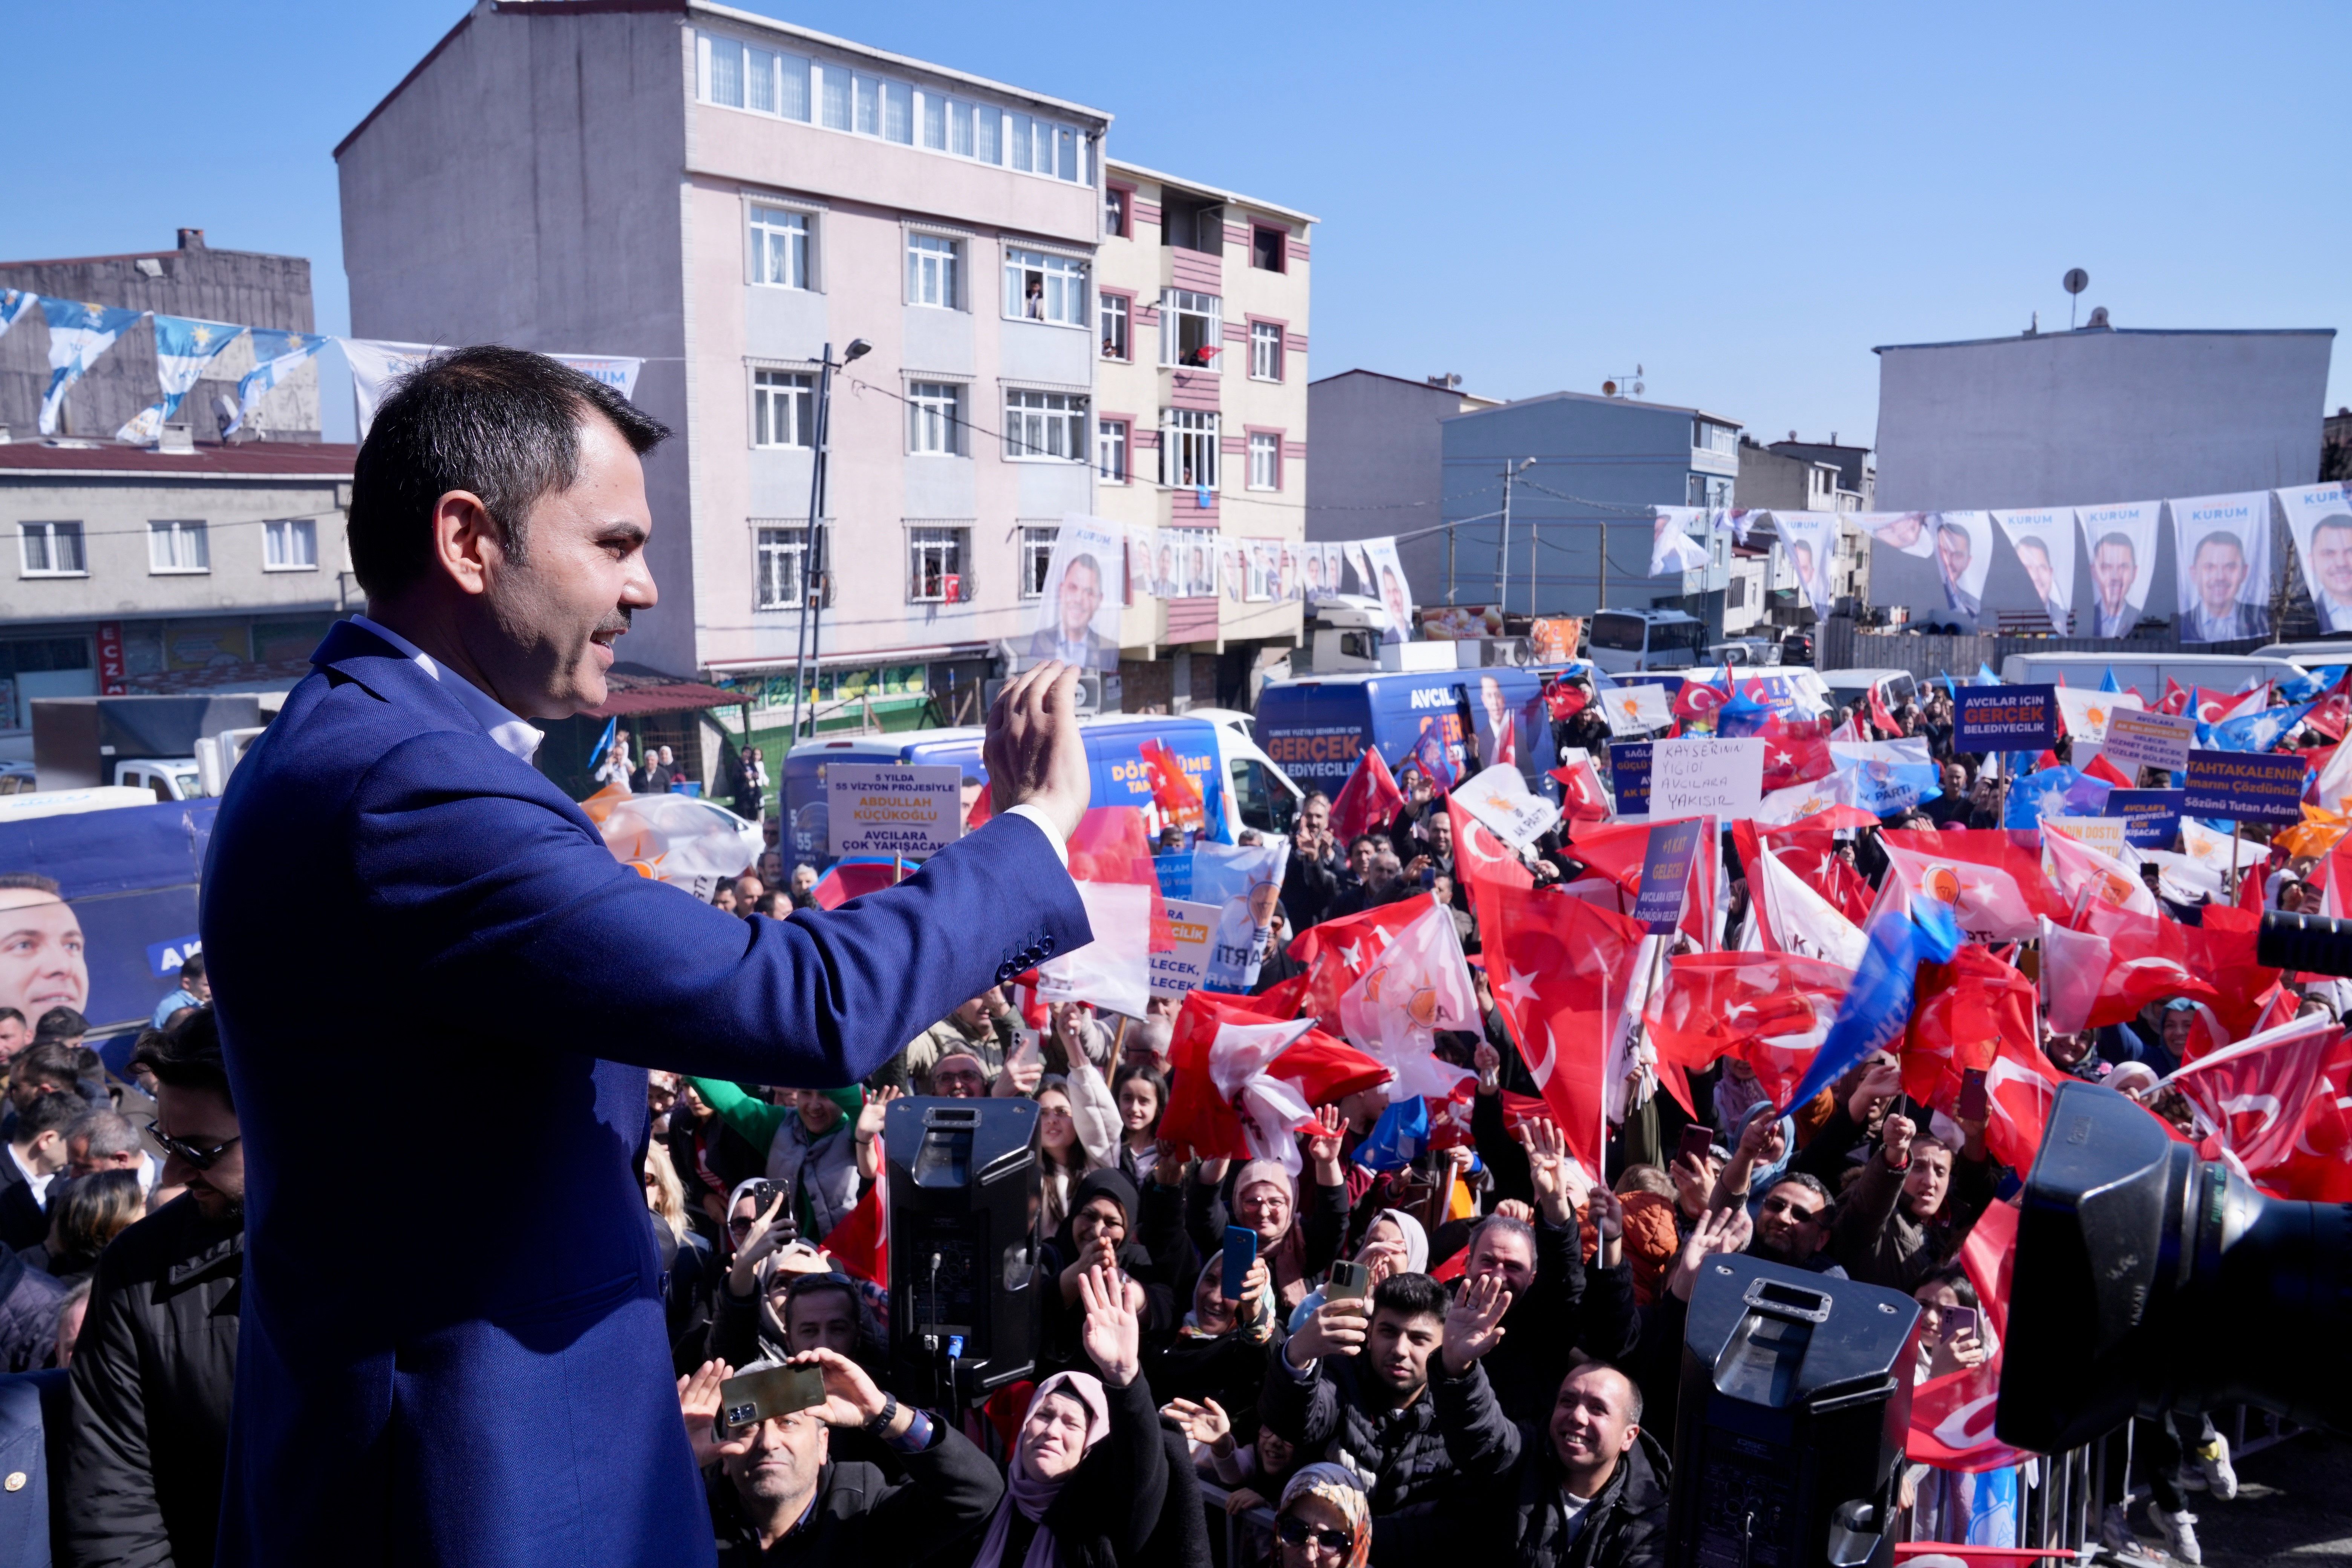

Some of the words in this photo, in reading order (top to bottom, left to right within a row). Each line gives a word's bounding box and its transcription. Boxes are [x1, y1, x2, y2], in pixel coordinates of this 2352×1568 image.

[2008, 515, 2052, 525] KURUM
[2090, 509, 2139, 522] KURUM
[2192, 507, 2248, 521] KURUM
[1075, 528, 1112, 545] KURUM
[1965, 697, 2017, 707] AVCILAR
[2020, 695, 2044, 707] İÇİN
[1965, 706, 2045, 724] GERÇEK
[1964, 722, 2045, 735] BELEDİYECİLİK
[1268, 735, 1361, 763] GERÇEK
[1625, 748, 1652, 758] SAĞLA
[1112, 755, 1212, 781] DÖNÜME
[1617, 761, 1647, 772] GÜÇLÜ
[2188, 760, 2303, 781] TAHTAKALENİN
[852, 781, 888, 791] VİZYON
[892, 782, 955, 792] PROJESİYLE
[859, 797, 932, 807] ABDULLAH
[2184, 796, 2226, 810] Sözünü
[2229, 800, 2260, 813] Tutan
[2262, 803, 2298, 816] Adam
[790, 809, 798, 827] 5
[854, 809, 938, 822] KÜÇÜKOĞLU
[796, 831, 812, 851] 55
[865, 831, 927, 841] AVCILARA
[842, 840, 869, 851] ÇOK
[874, 841, 949, 852] YAKIŞACAK
[1672, 836, 1688, 853] KAT
[1652, 862, 1686, 880] GELECEK
